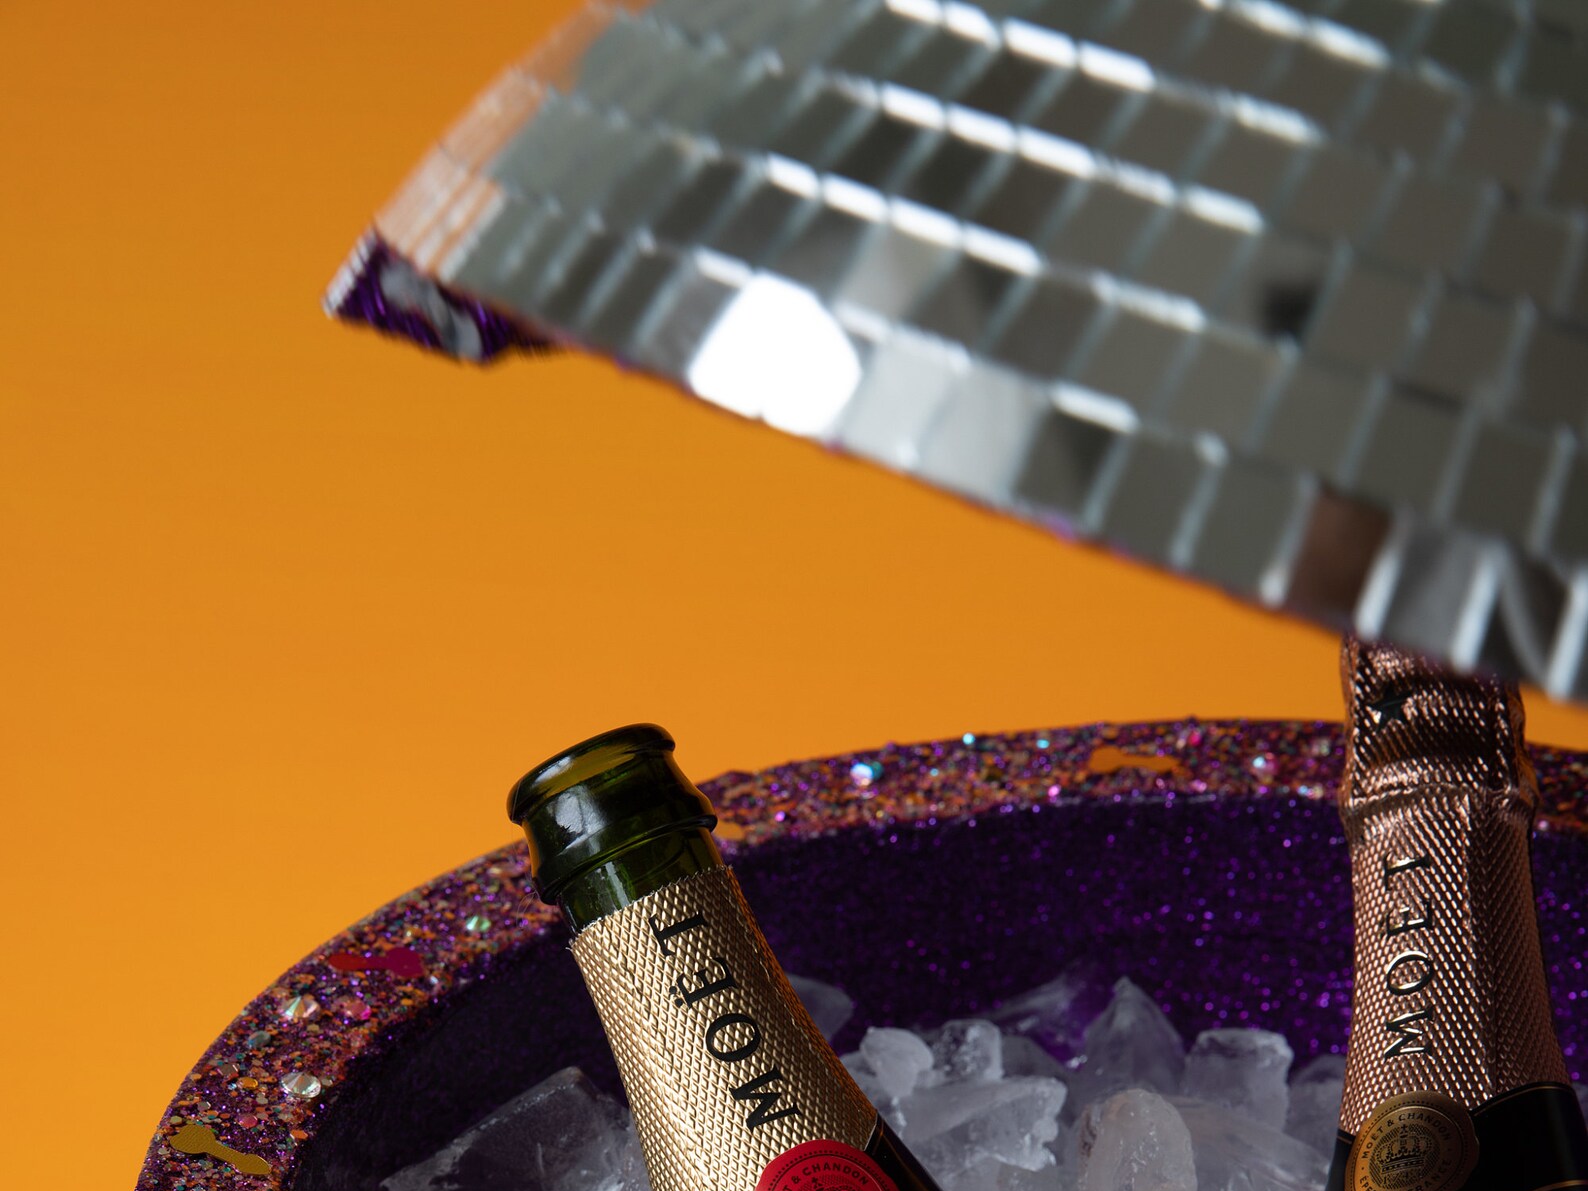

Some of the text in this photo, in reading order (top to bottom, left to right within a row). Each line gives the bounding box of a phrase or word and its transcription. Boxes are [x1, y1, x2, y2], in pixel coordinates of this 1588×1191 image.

[650, 912, 801, 1130] MOËT
[1387, 1119, 1395, 1127] &
[1398, 1112, 1451, 1141] CHANDON
[791, 1175, 801, 1185] &
[802, 1162, 869, 1186] CHANDON
